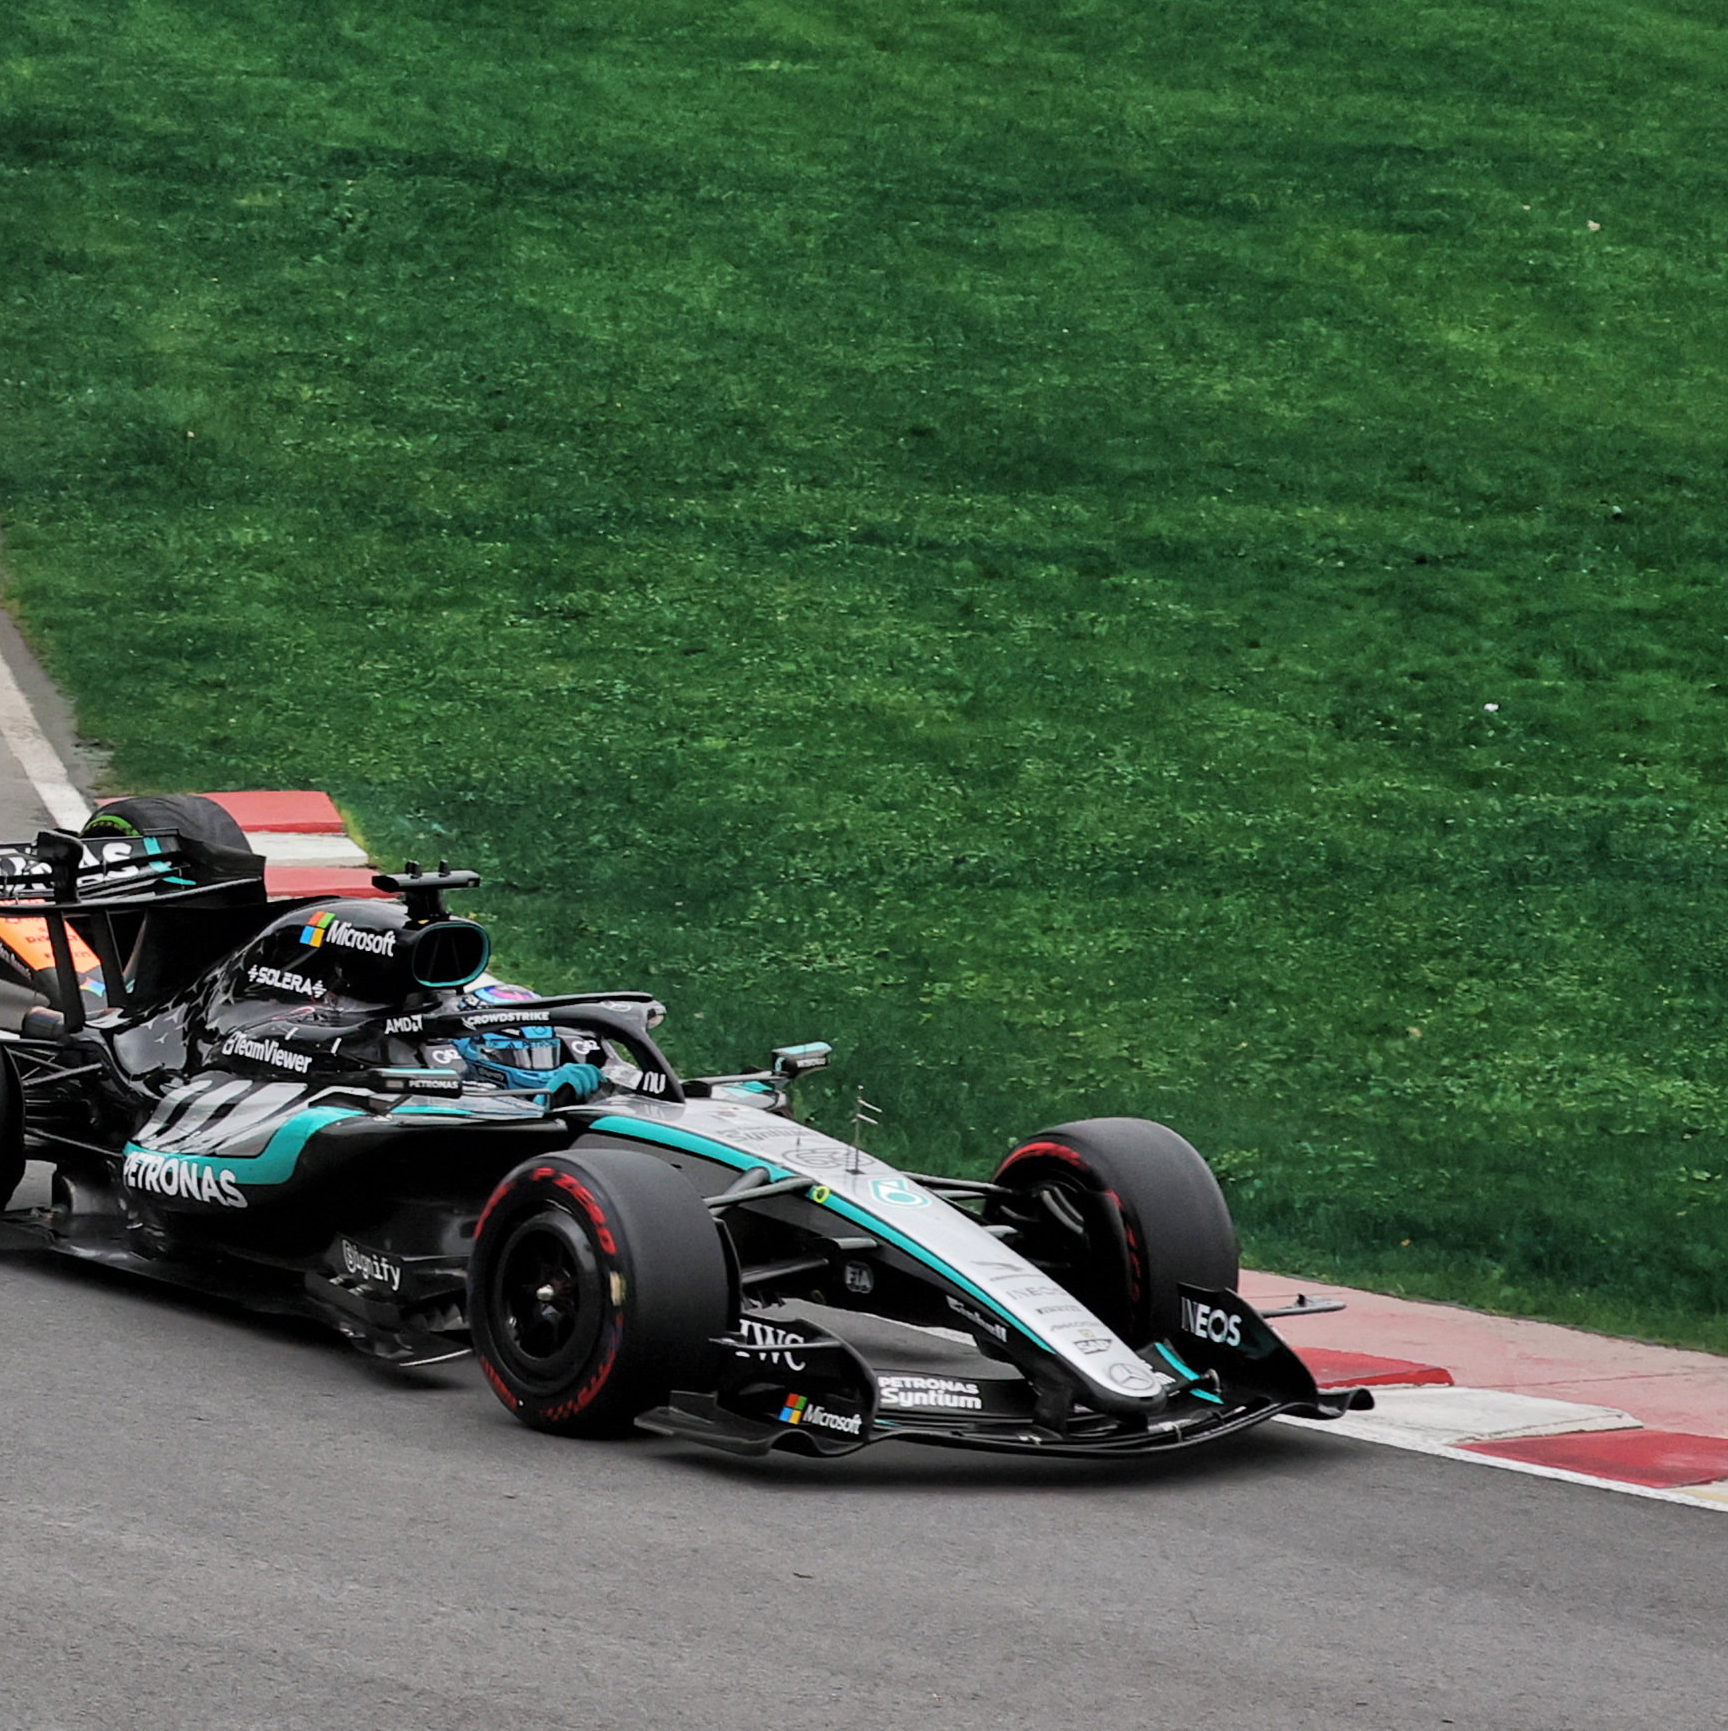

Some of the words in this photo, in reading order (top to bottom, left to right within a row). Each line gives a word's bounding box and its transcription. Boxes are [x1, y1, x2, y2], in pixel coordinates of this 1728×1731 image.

[326, 920, 396, 957] Microsoft
[256, 966, 313, 996] SOLERA
[384, 1016, 411, 1036] AMD
[465, 1011, 550, 1027] CROWDSTRIKE
[234, 1031, 313, 1073] TeamViewer
[408, 1080, 459, 1091] PETRONAS
[642, 1070, 667, 1094] nu
[123, 1151, 249, 1209] PETRONAS
[1180, 1296, 1243, 1347] INEOS
[735, 1319, 807, 1371] IWC
[1075, 1339, 1112, 1354] SAP
[877, 1376, 980, 1395] PETRONAS
[880, 1388, 983, 1410] Syntium
[803, 1404, 863, 1434] Microsoft
